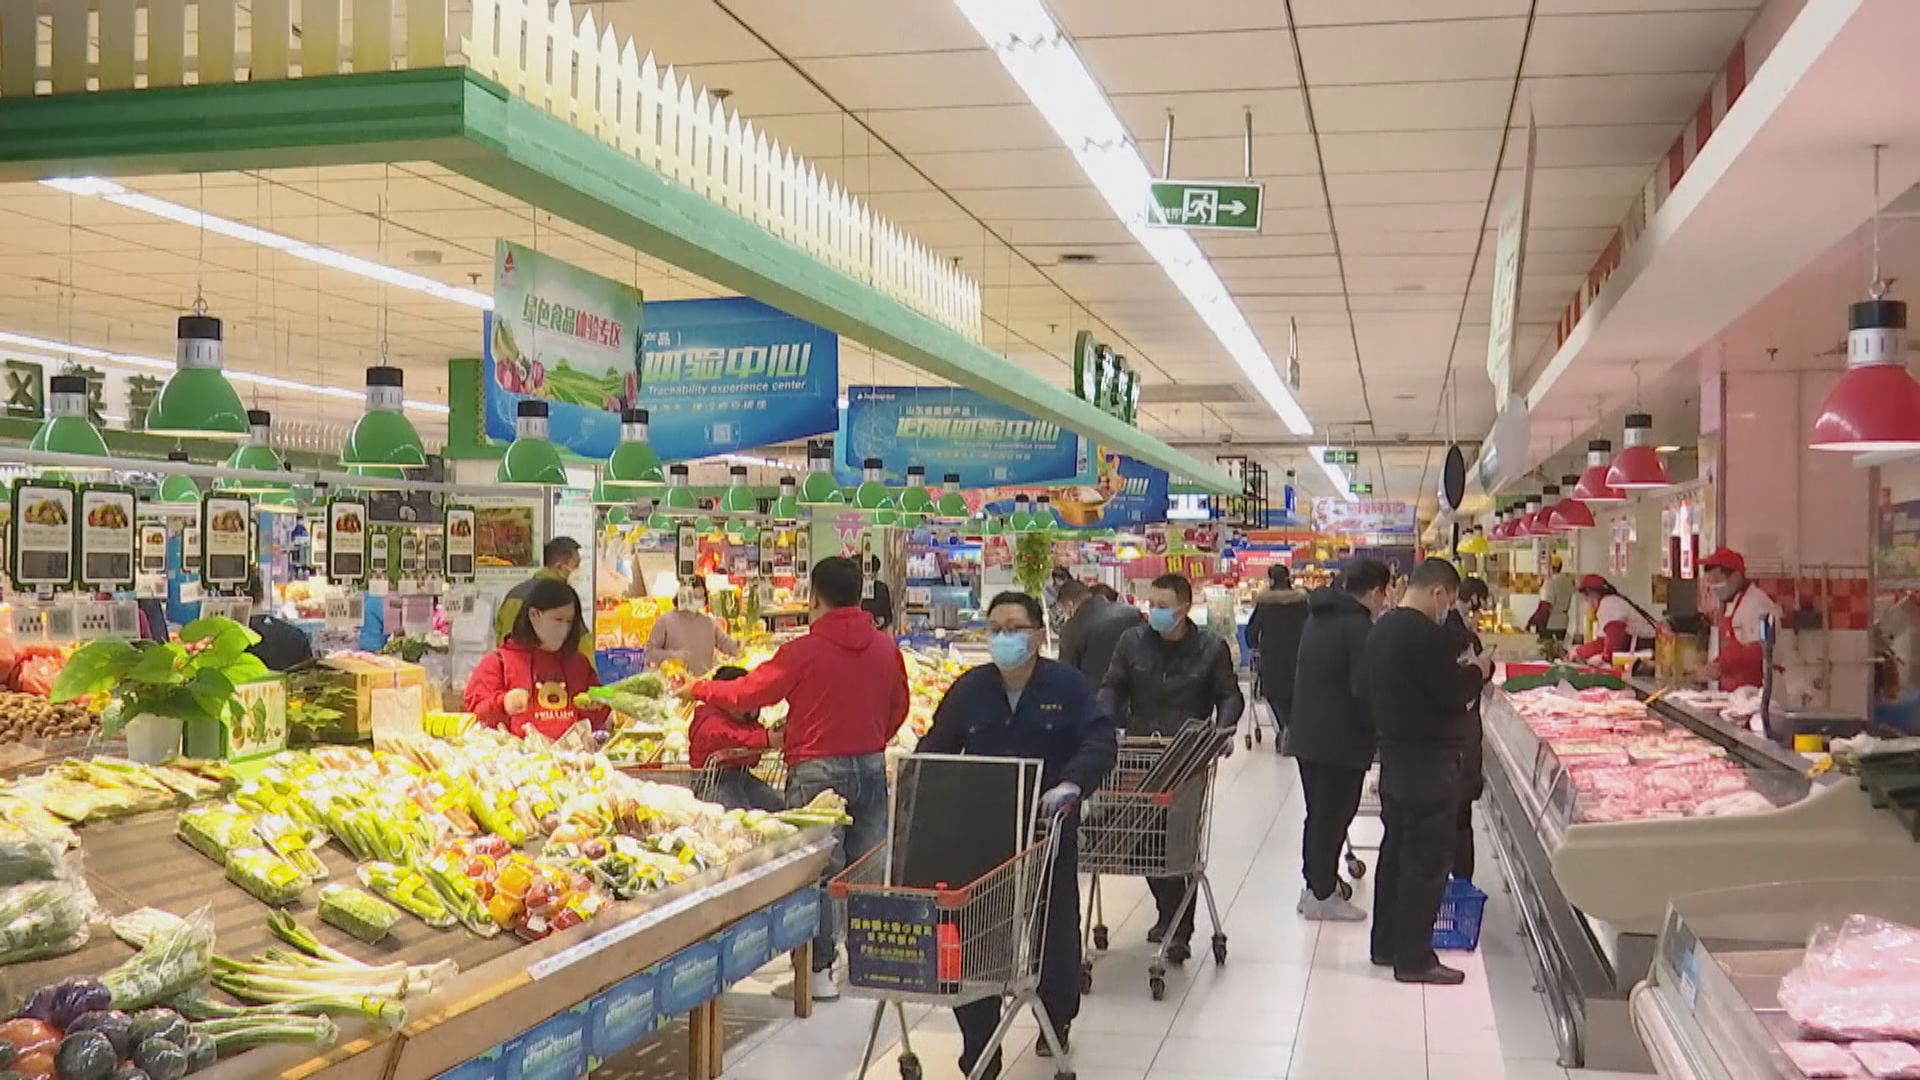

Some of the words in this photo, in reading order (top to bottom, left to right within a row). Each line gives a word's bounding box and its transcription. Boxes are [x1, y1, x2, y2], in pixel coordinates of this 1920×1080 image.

[521, 293, 622, 347] 绿色食品体验专区
[648, 384, 708, 396] Traceability
[711, 381, 768, 394] experience
[771, 380, 807, 391] center
